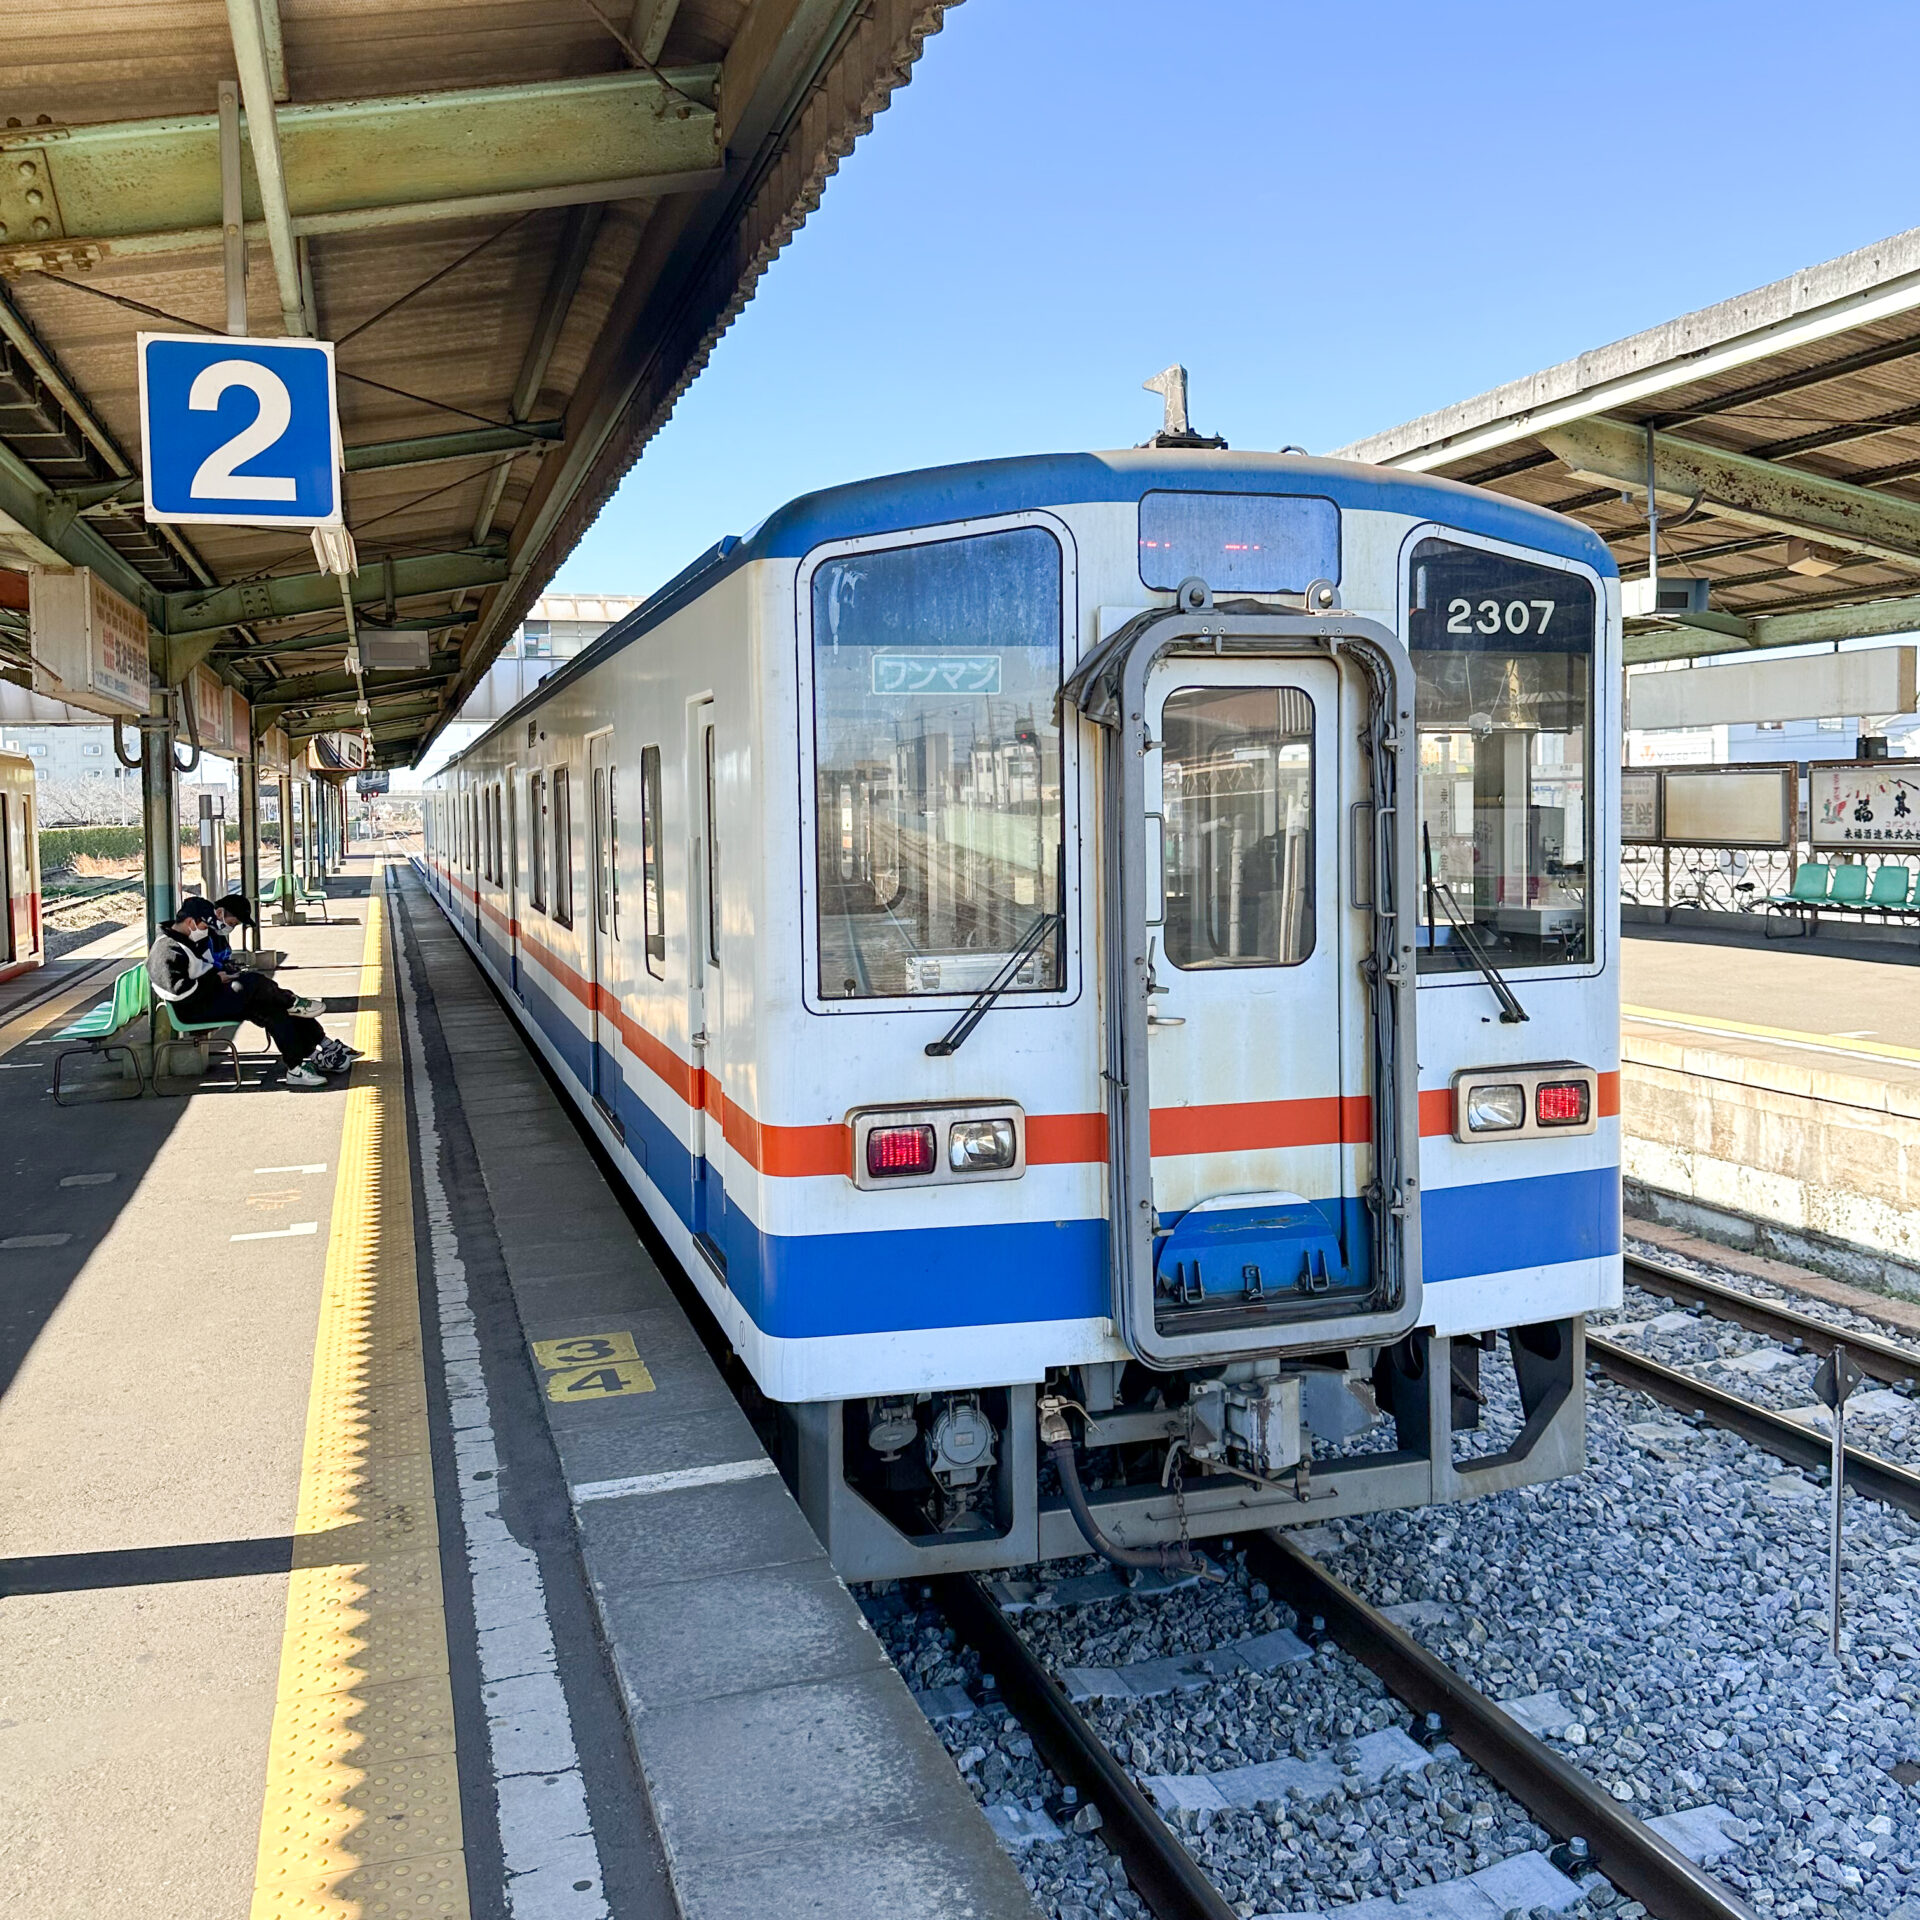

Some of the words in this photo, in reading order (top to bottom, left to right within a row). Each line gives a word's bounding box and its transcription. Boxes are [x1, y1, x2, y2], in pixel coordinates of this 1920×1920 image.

[188, 358, 297, 502] 2
[1446, 597, 1556, 636] 2307
[878, 660, 996, 690] ワンマン
[555, 1339, 617, 1363] 3
[567, 1368, 632, 1393] 4
